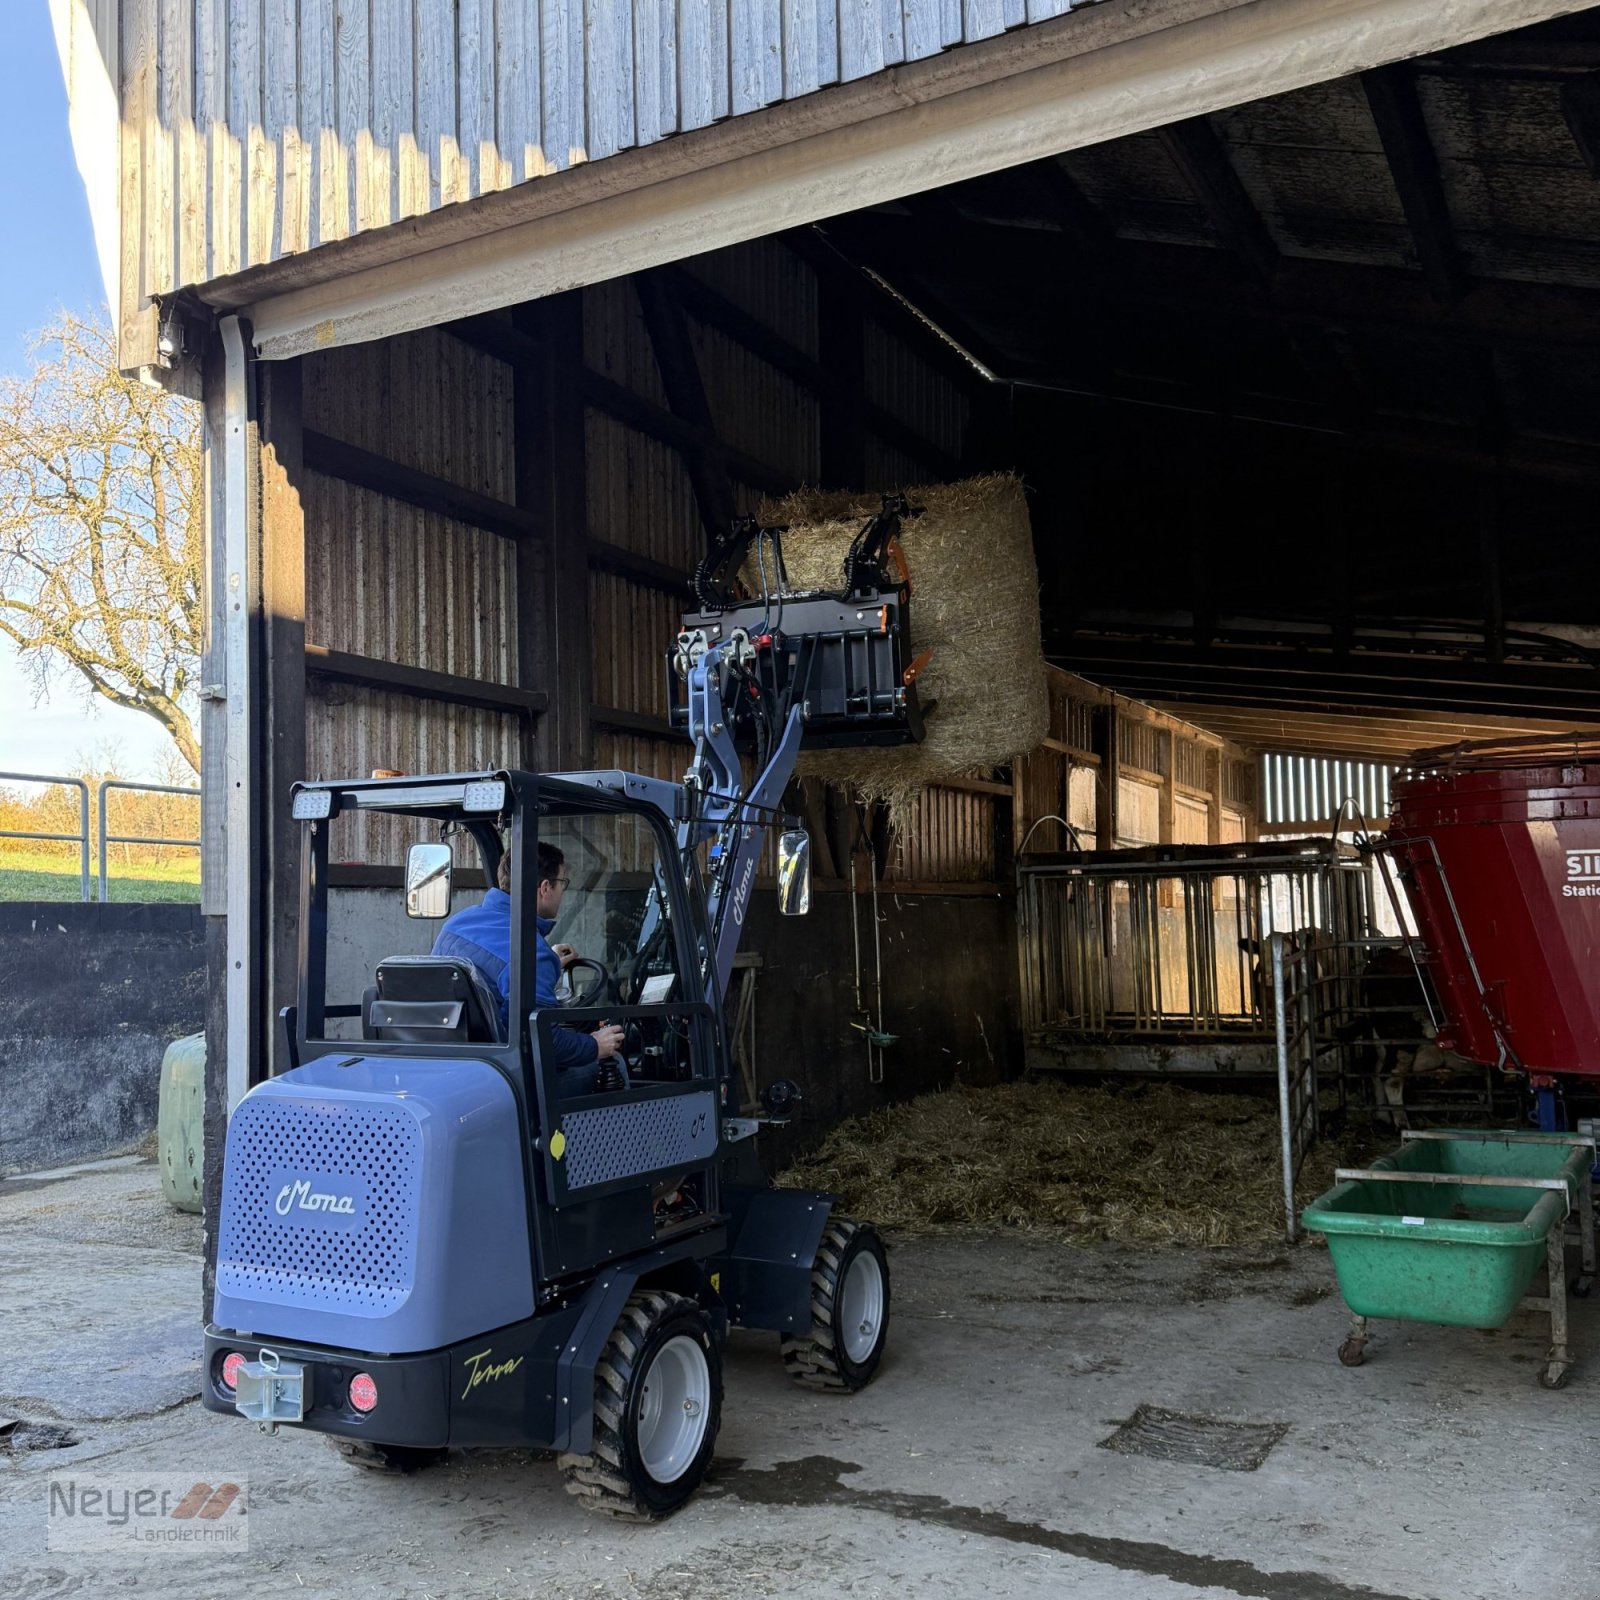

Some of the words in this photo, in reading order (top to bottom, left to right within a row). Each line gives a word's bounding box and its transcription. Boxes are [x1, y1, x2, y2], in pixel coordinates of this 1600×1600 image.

[733, 857, 753, 925] Mona
[276, 1179, 356, 1216] Mona
[461, 1348, 524, 1400] Terra
